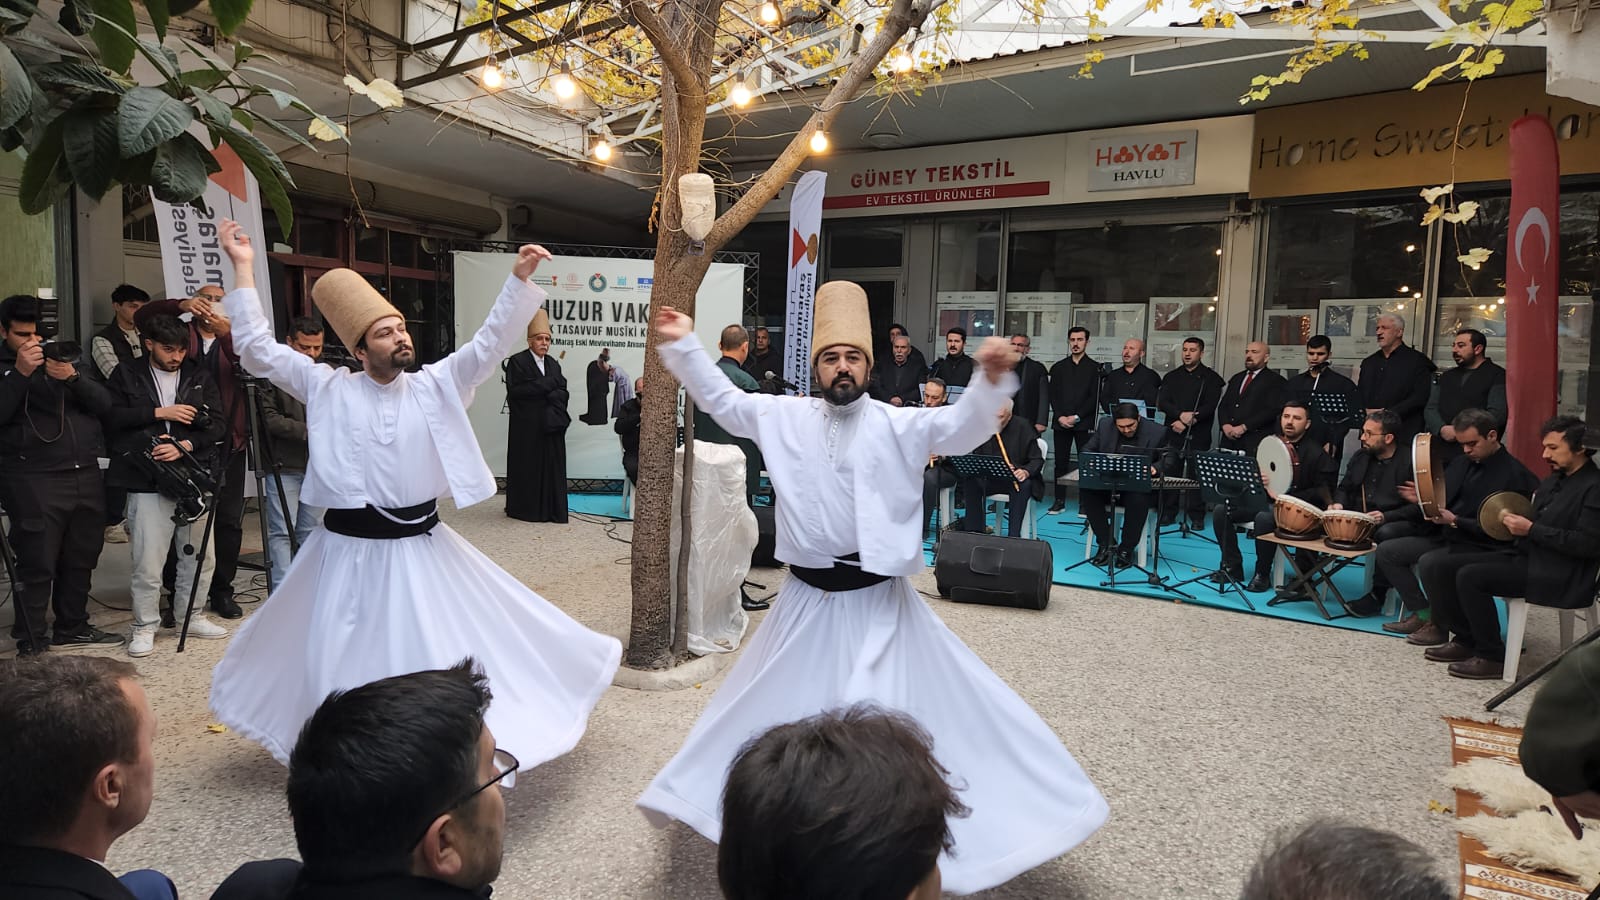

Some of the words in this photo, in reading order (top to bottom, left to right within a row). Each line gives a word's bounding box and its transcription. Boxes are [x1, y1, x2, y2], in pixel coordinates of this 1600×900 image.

[1259, 135, 1360, 169] Home
[1374, 115, 1504, 157] Sweet
[850, 168, 918, 189] GÜNEY
[925, 157, 1015, 183] TEKSTİL
[1114, 168, 1165, 182] HAVLU
[865, 196, 880, 206] EV
[883, 191, 930, 205] TEKSTİL
[935, 185, 996, 201] ÜRÜNLERİ
[611, 302, 650, 324] VAK
[557, 325, 603, 336] TASAVVUF
[794, 273, 807, 397] ahramanmaraş
